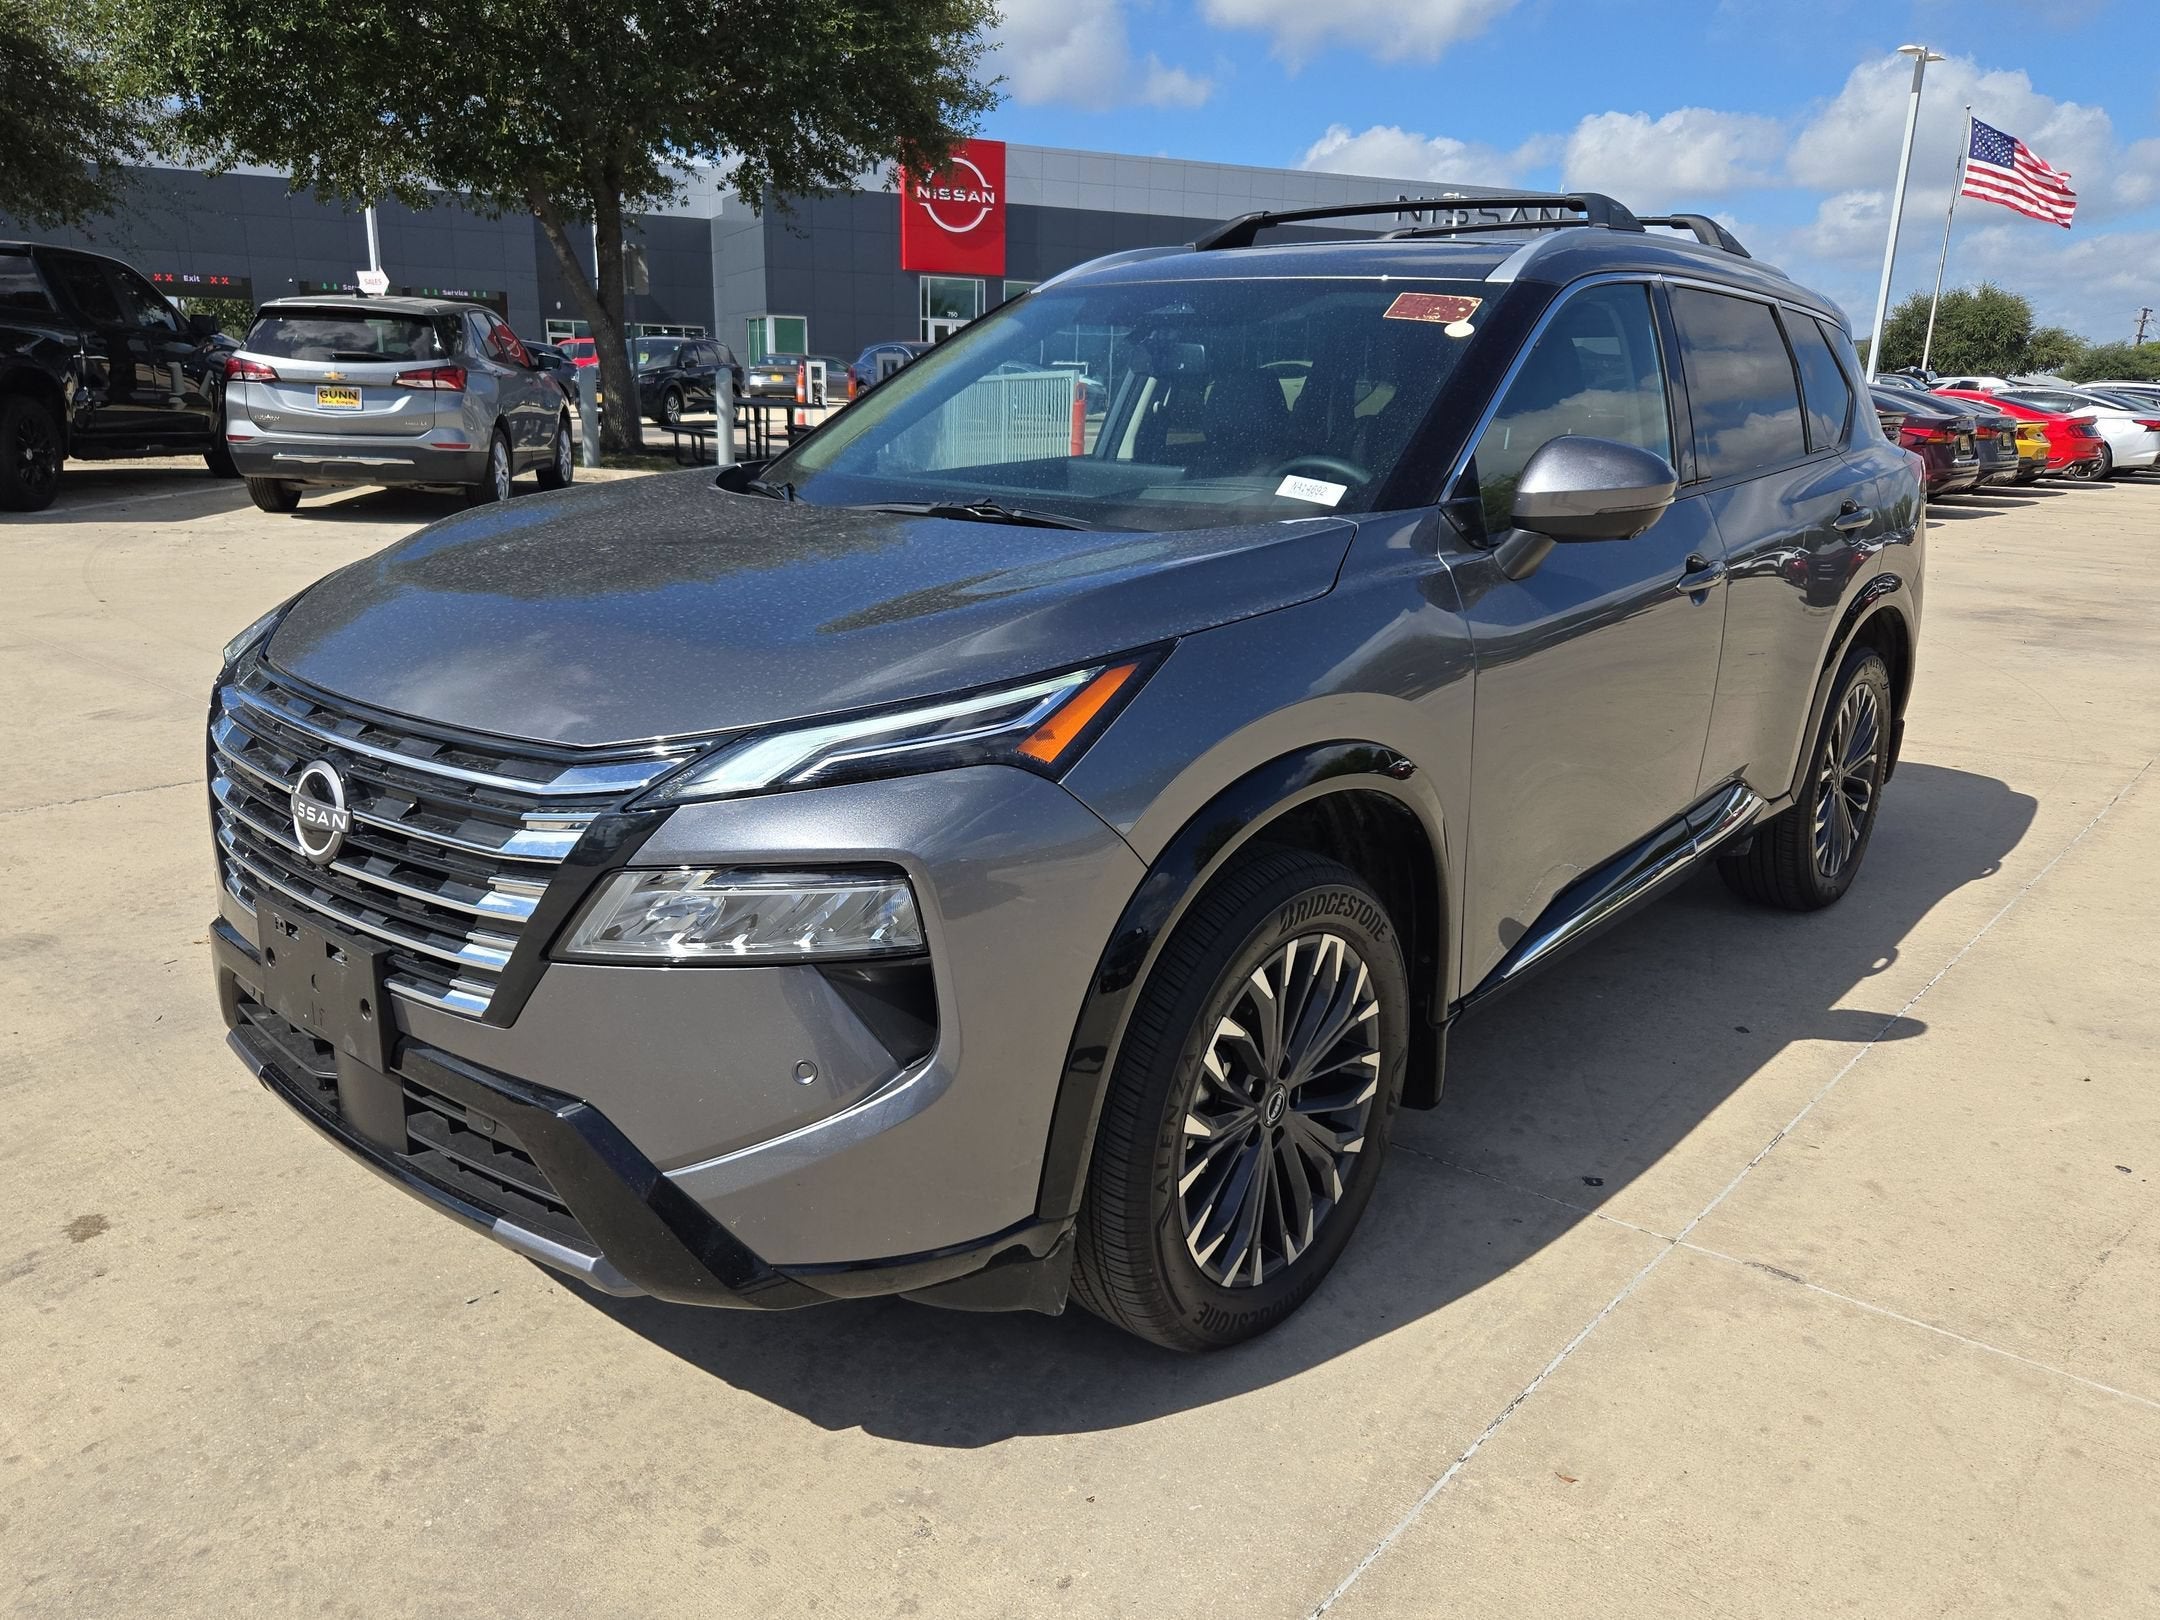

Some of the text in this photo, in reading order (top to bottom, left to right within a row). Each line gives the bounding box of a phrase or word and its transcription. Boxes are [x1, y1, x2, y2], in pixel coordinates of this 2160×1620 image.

[917, 186, 995, 204] NISSAN
[183, 274, 200, 283] Exit
[364, 278, 383, 286] SALES
[320, 390, 357, 400] GUNN
[296, 800, 347, 830] SSAN
[1278, 892, 1389, 943] BRIDGESTONE
[1155, 1052, 1196, 1195] ALENZA
